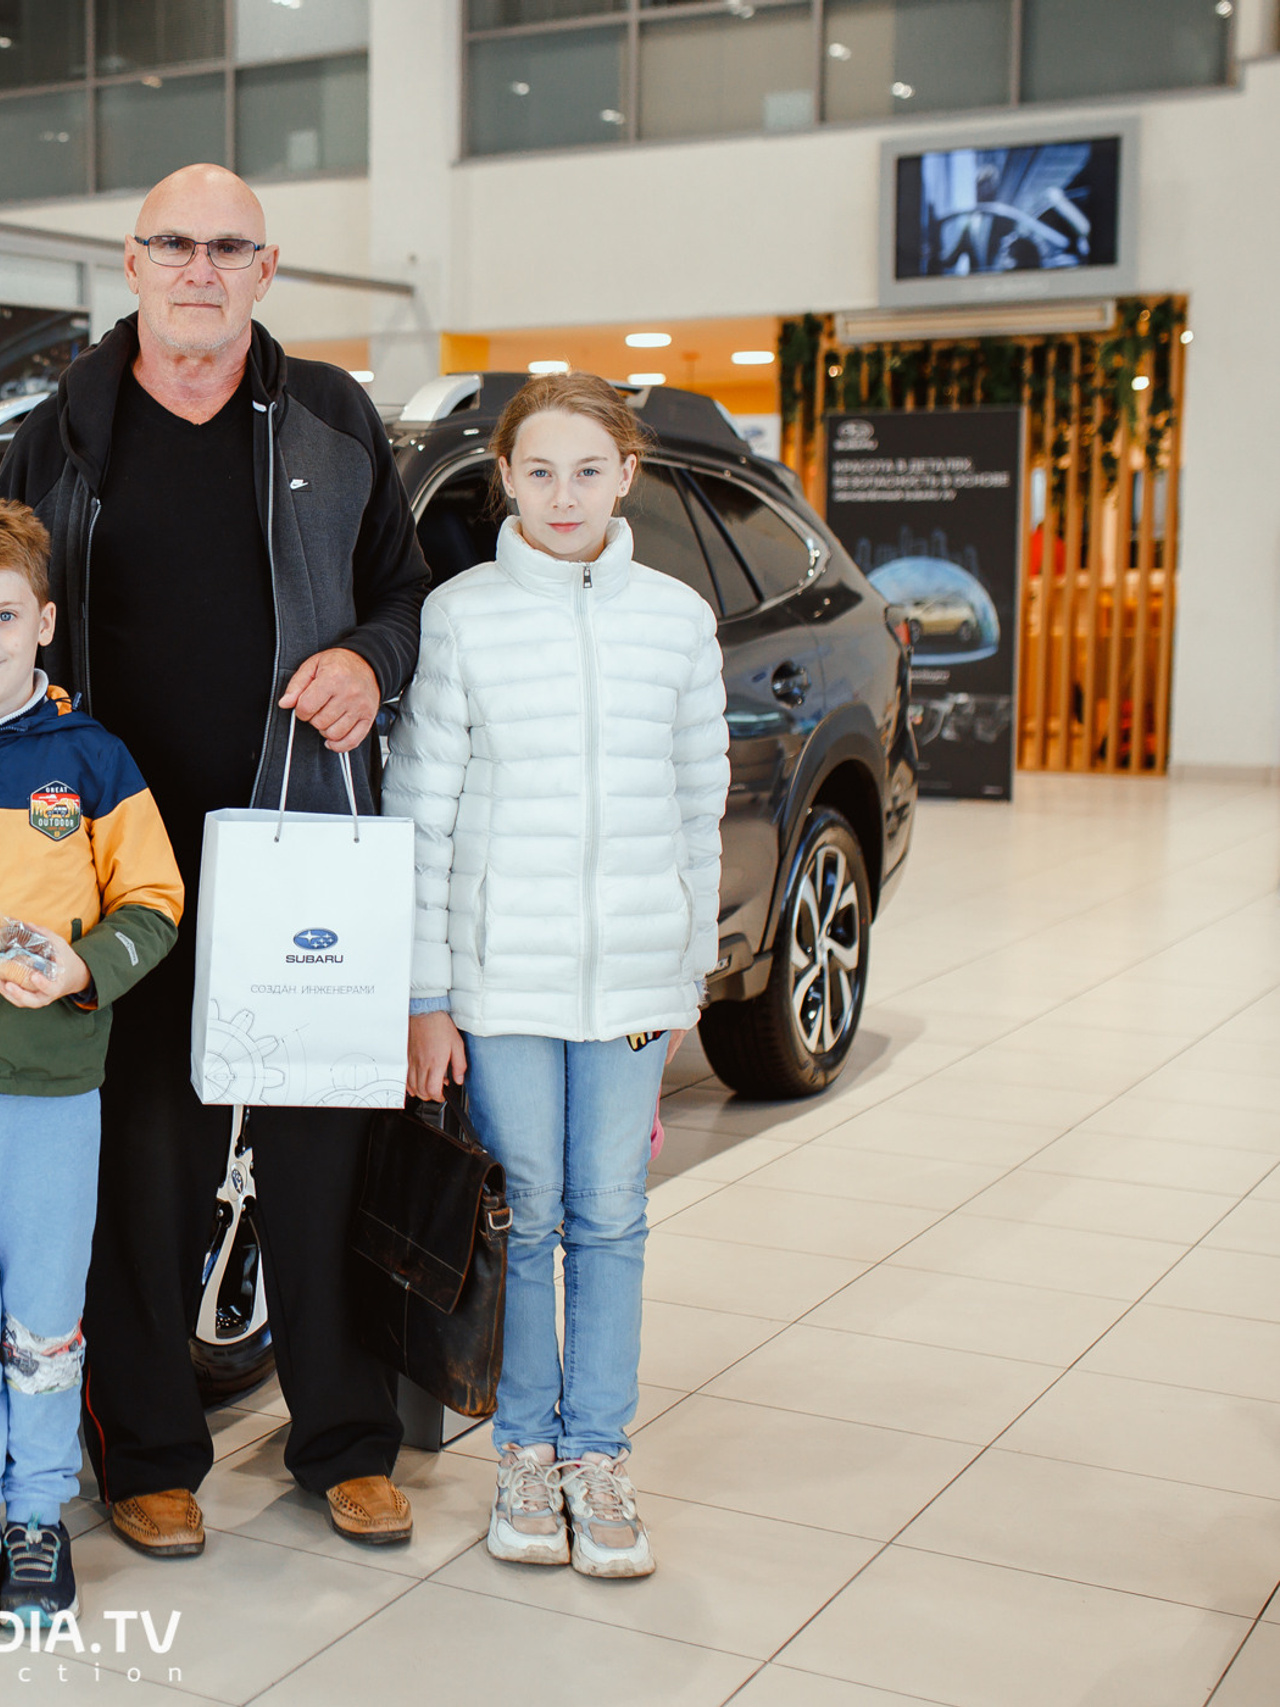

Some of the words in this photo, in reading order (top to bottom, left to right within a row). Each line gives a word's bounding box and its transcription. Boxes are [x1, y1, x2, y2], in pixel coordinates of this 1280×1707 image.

[45, 786, 68, 794] GREAT
[38, 818, 75, 828] OUTDOOR
[285, 954, 344, 964] SUBARU
[250, 984, 297, 995] СОЗДАН
[301, 985, 376, 995] ИНЖЕНЕРАМИ
